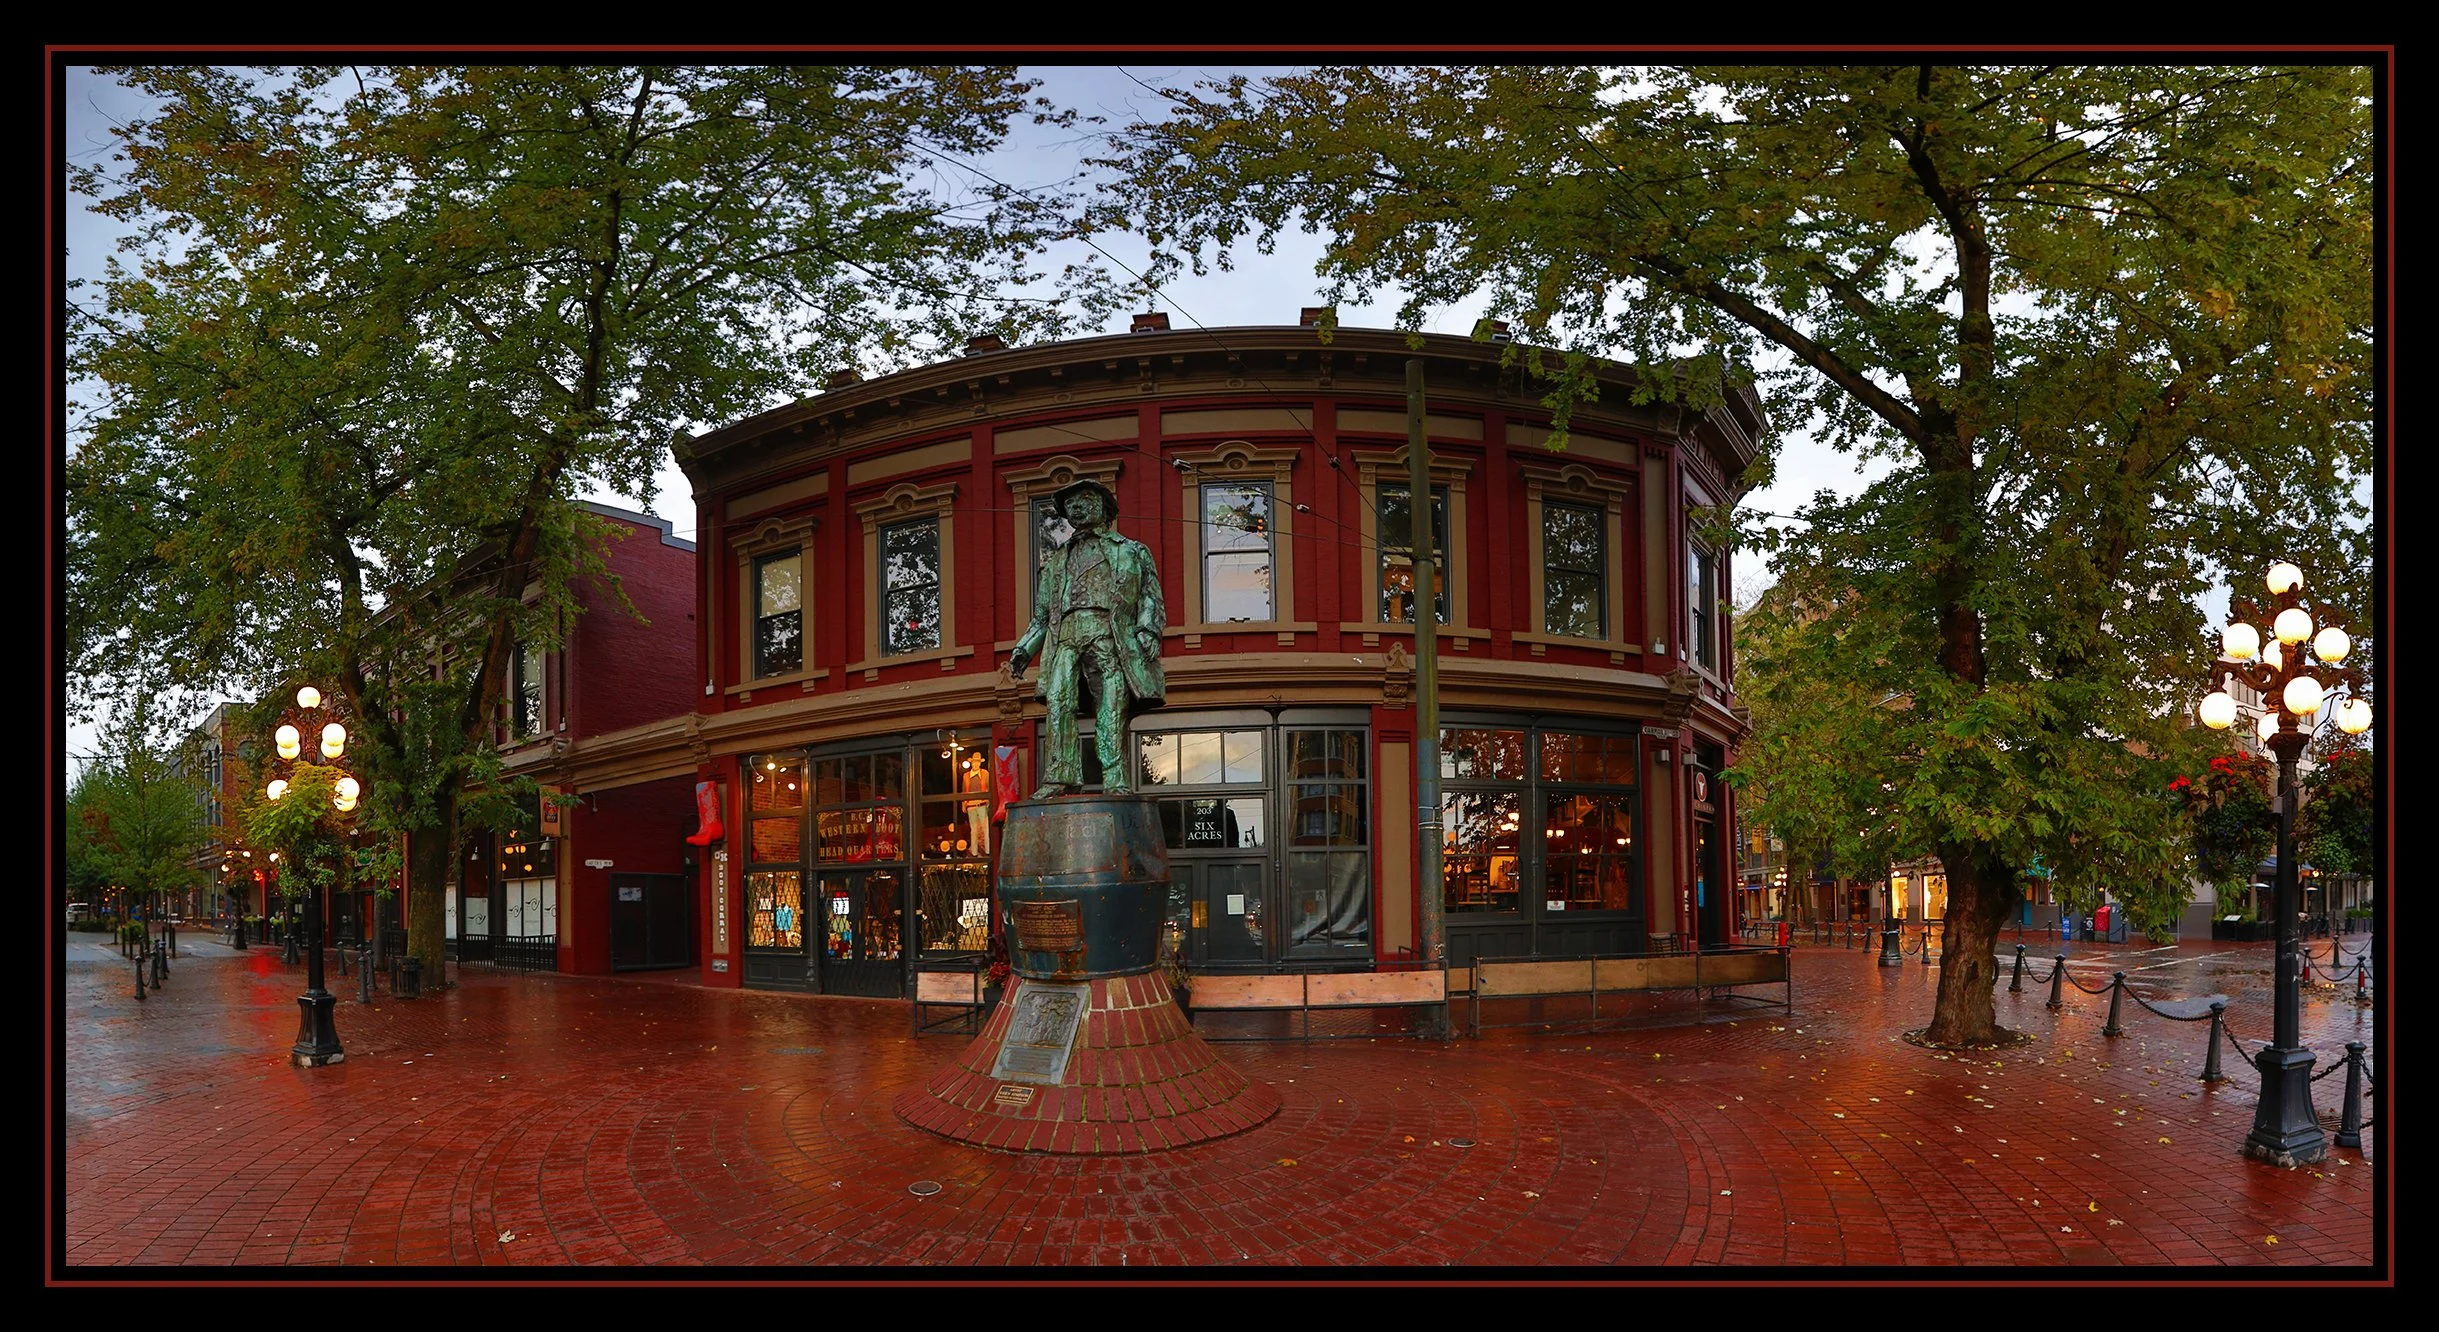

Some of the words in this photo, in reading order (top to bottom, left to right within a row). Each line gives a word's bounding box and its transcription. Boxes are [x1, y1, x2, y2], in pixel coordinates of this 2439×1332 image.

[820, 823, 866, 838] WESTERN
[876, 823, 900, 834] BOOT
[1195, 822, 1214, 830] SIX
[1188, 831, 1222, 840] ACRES
